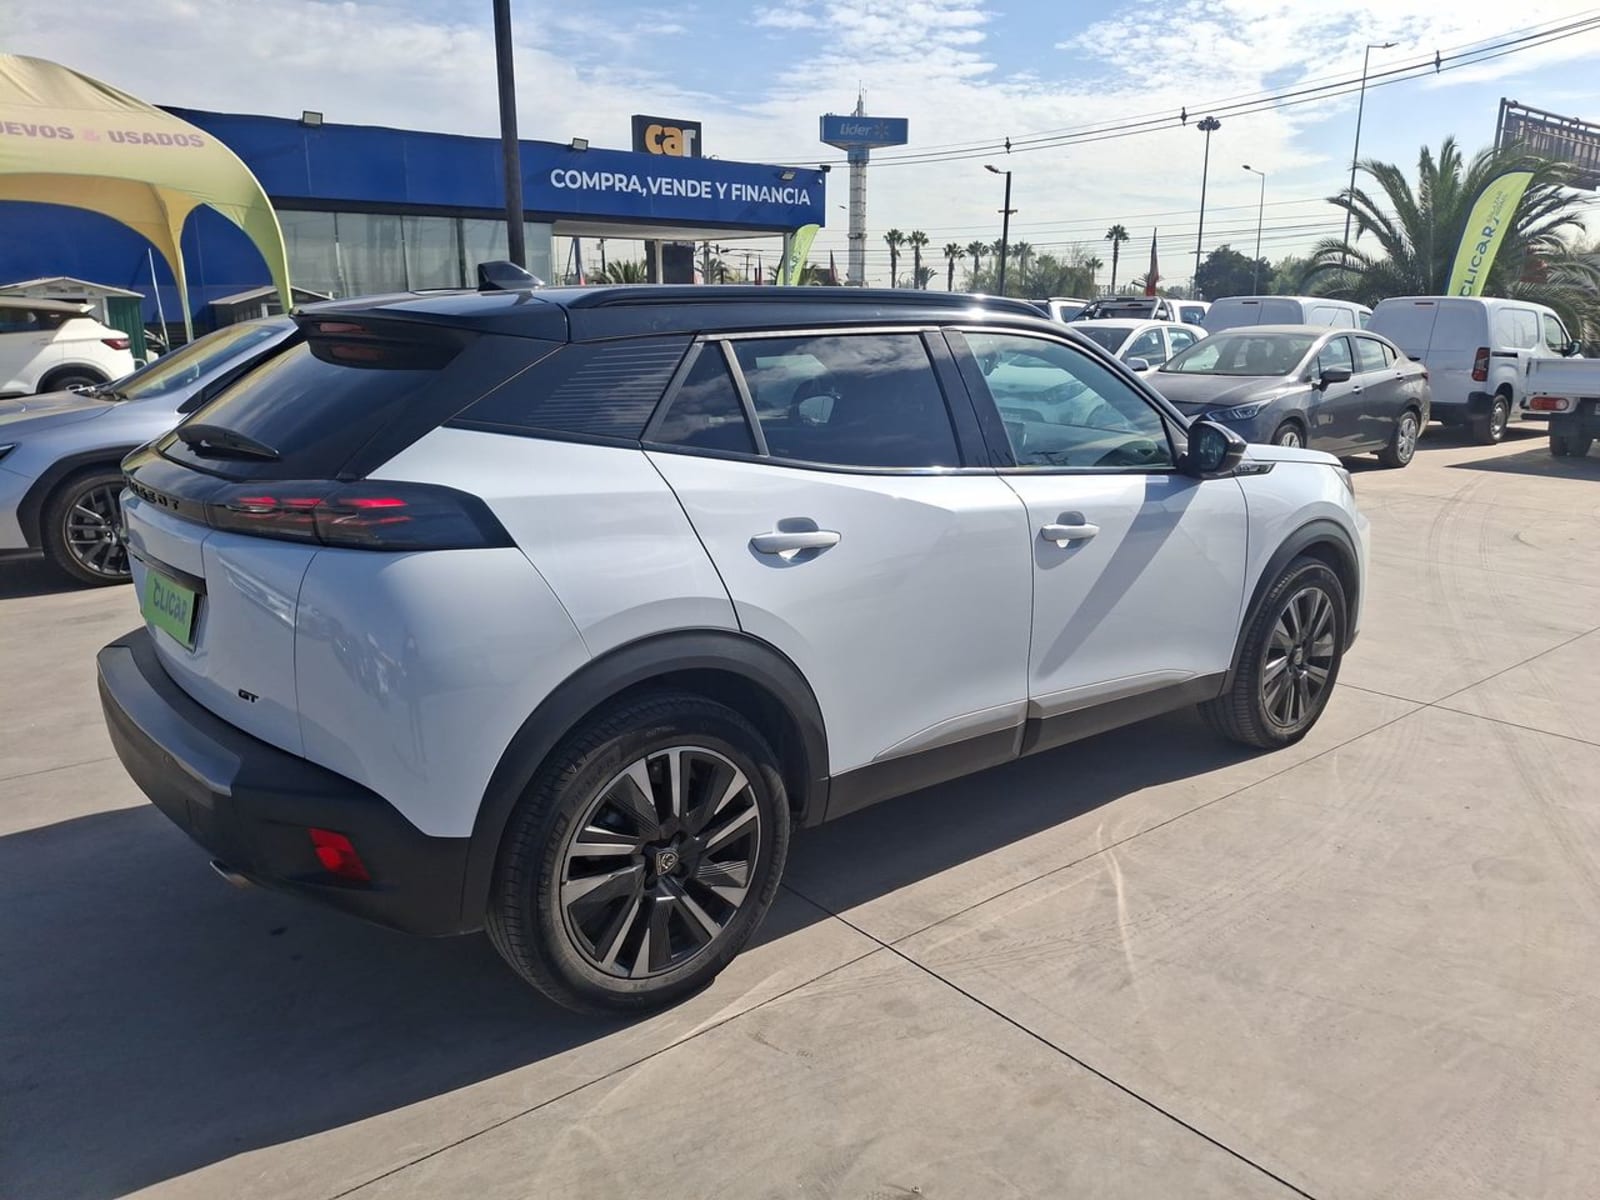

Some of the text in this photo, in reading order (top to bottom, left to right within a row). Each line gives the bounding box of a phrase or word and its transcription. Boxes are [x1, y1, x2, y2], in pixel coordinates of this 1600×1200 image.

[0, 121, 74, 139] EVOS
[108, 131, 205, 148] USADOS
[716, 183, 728, 199] Y
[731, 184, 811, 206] FINANCIA
[238, 689, 259, 703] GT
